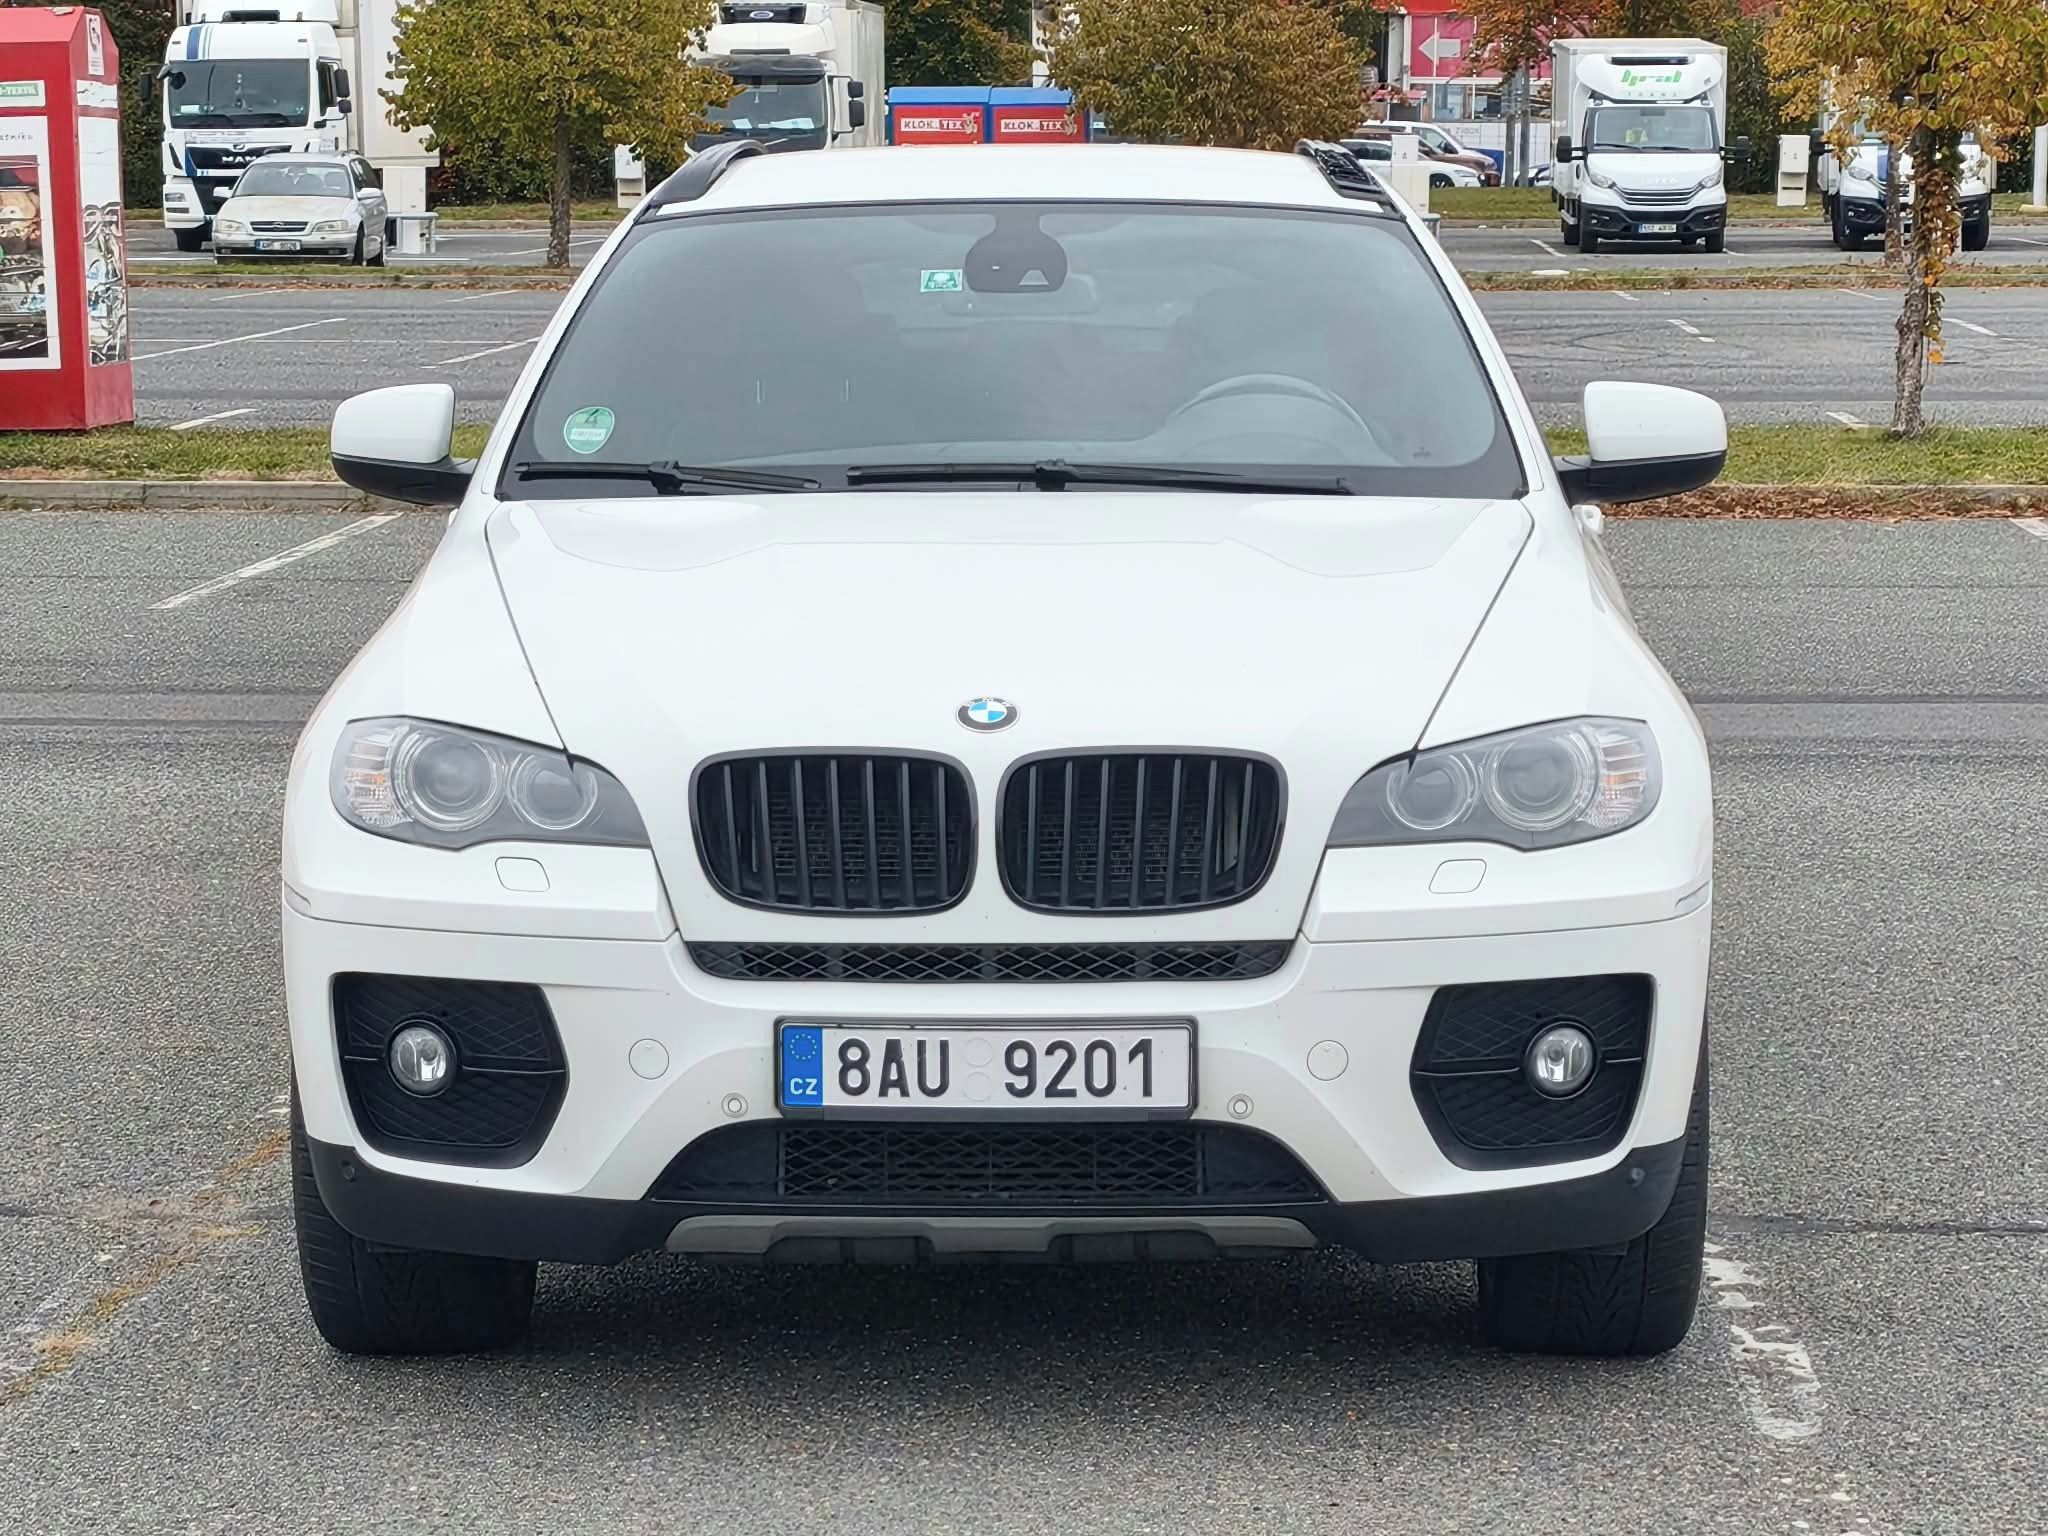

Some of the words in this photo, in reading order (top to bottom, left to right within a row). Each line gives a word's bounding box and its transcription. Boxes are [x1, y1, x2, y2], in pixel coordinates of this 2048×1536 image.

[221, 156, 257, 164] MAN
[837, 1037, 950, 1098] 8AU
[1003, 1038, 1153, 1099] 9201
[790, 1077, 818, 1095] CZ
